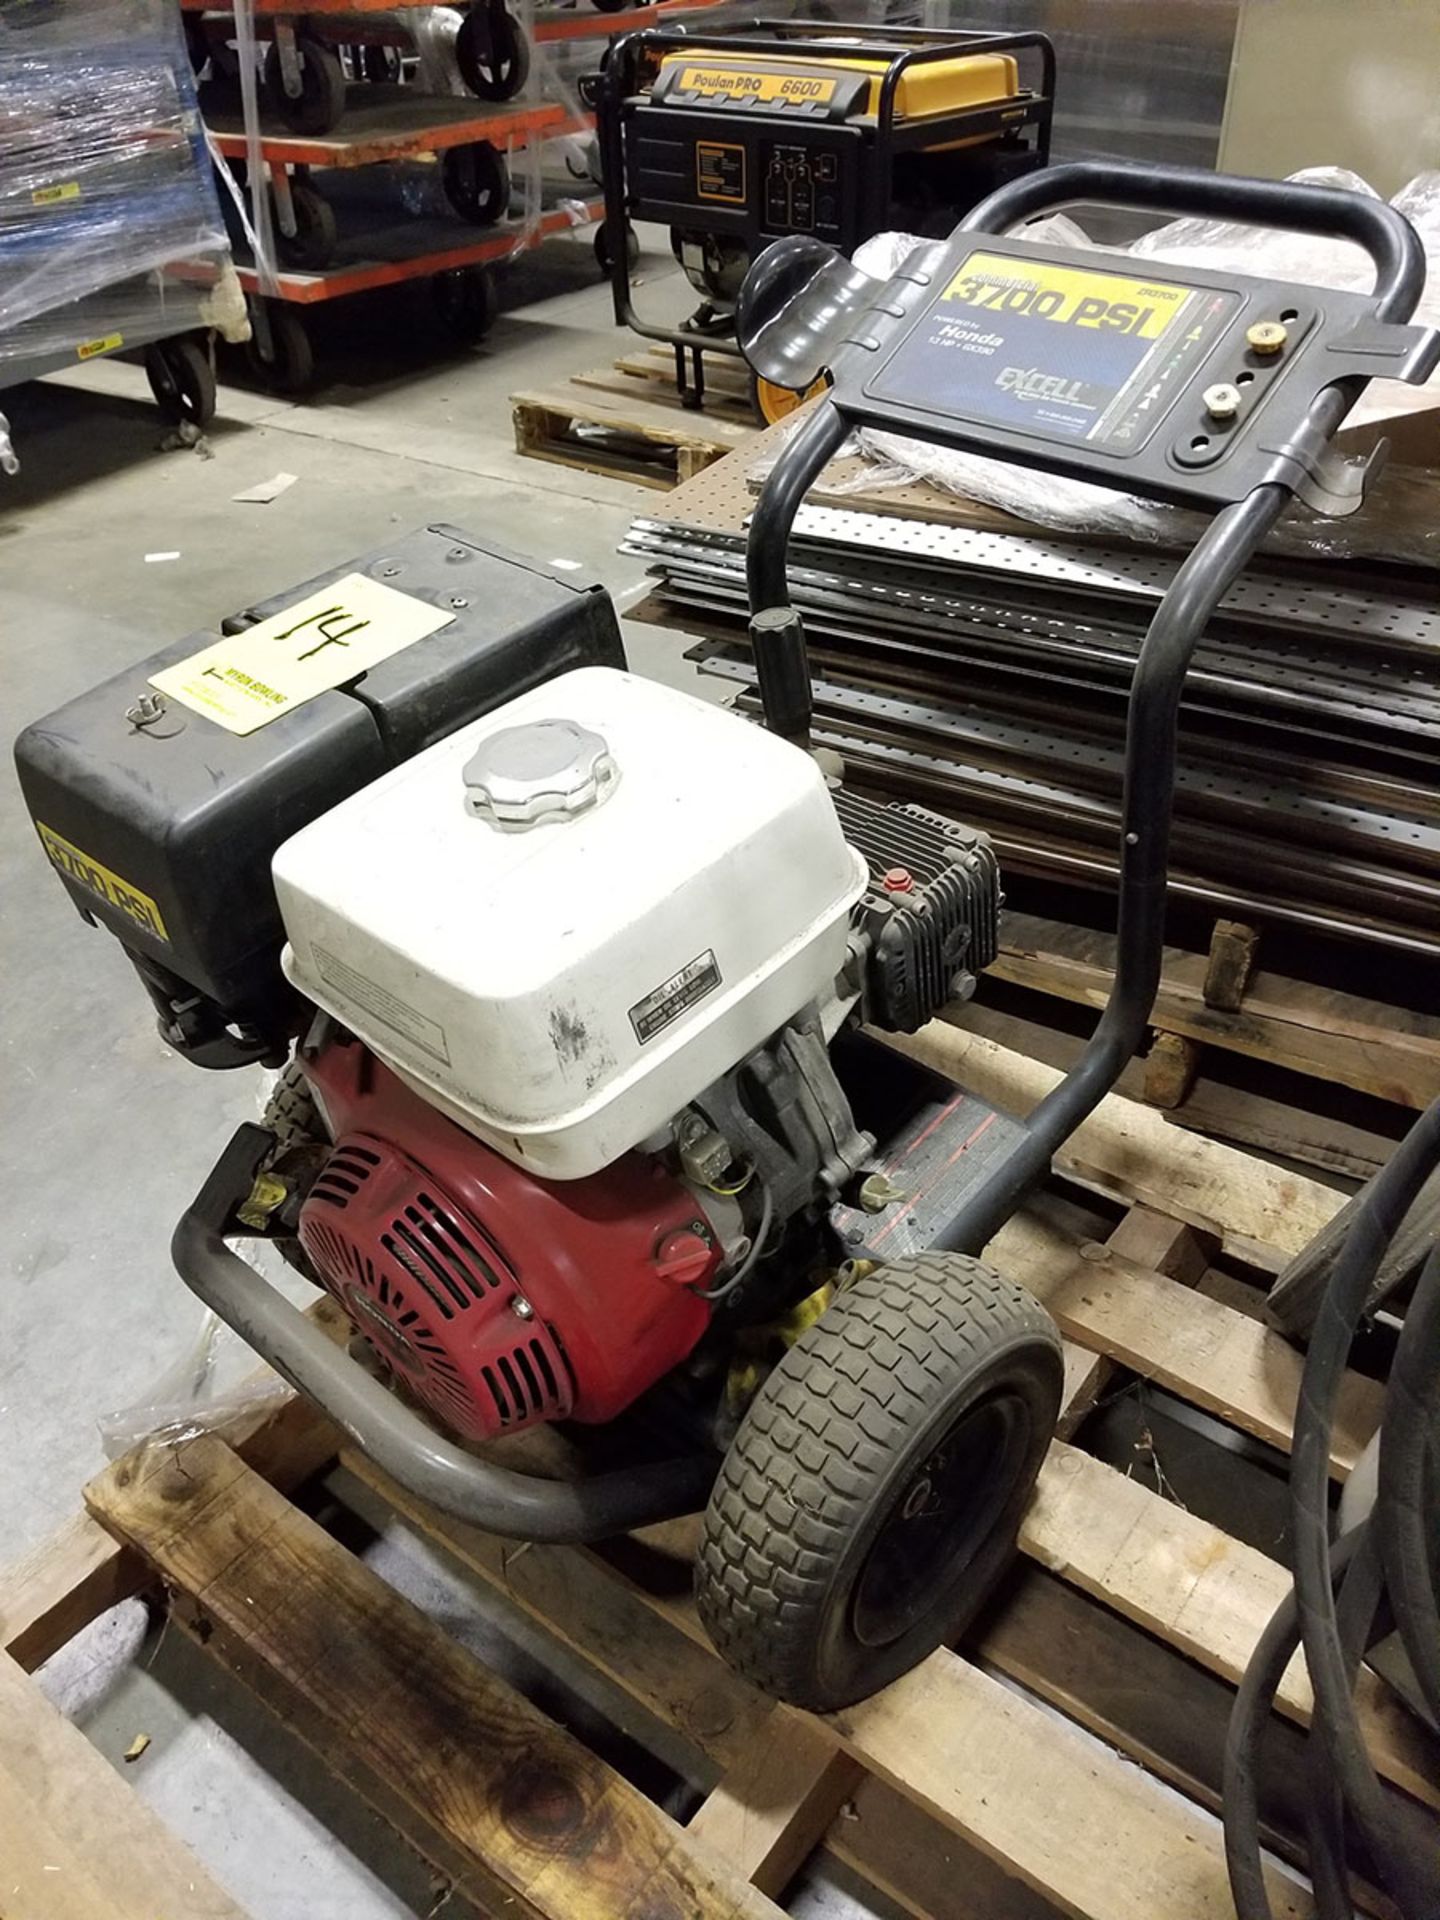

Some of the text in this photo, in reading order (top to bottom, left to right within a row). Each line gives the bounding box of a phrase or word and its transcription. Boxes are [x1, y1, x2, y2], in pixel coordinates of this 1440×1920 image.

[780, 80, 823, 97] 6600
[950, 276, 1156, 336] 3700 PSI
[938, 324, 1005, 347] Honda
[994, 366, 1083, 402] EXCELL
[273, 605, 371, 662] 14
[109, 881, 165, 943] PSI
